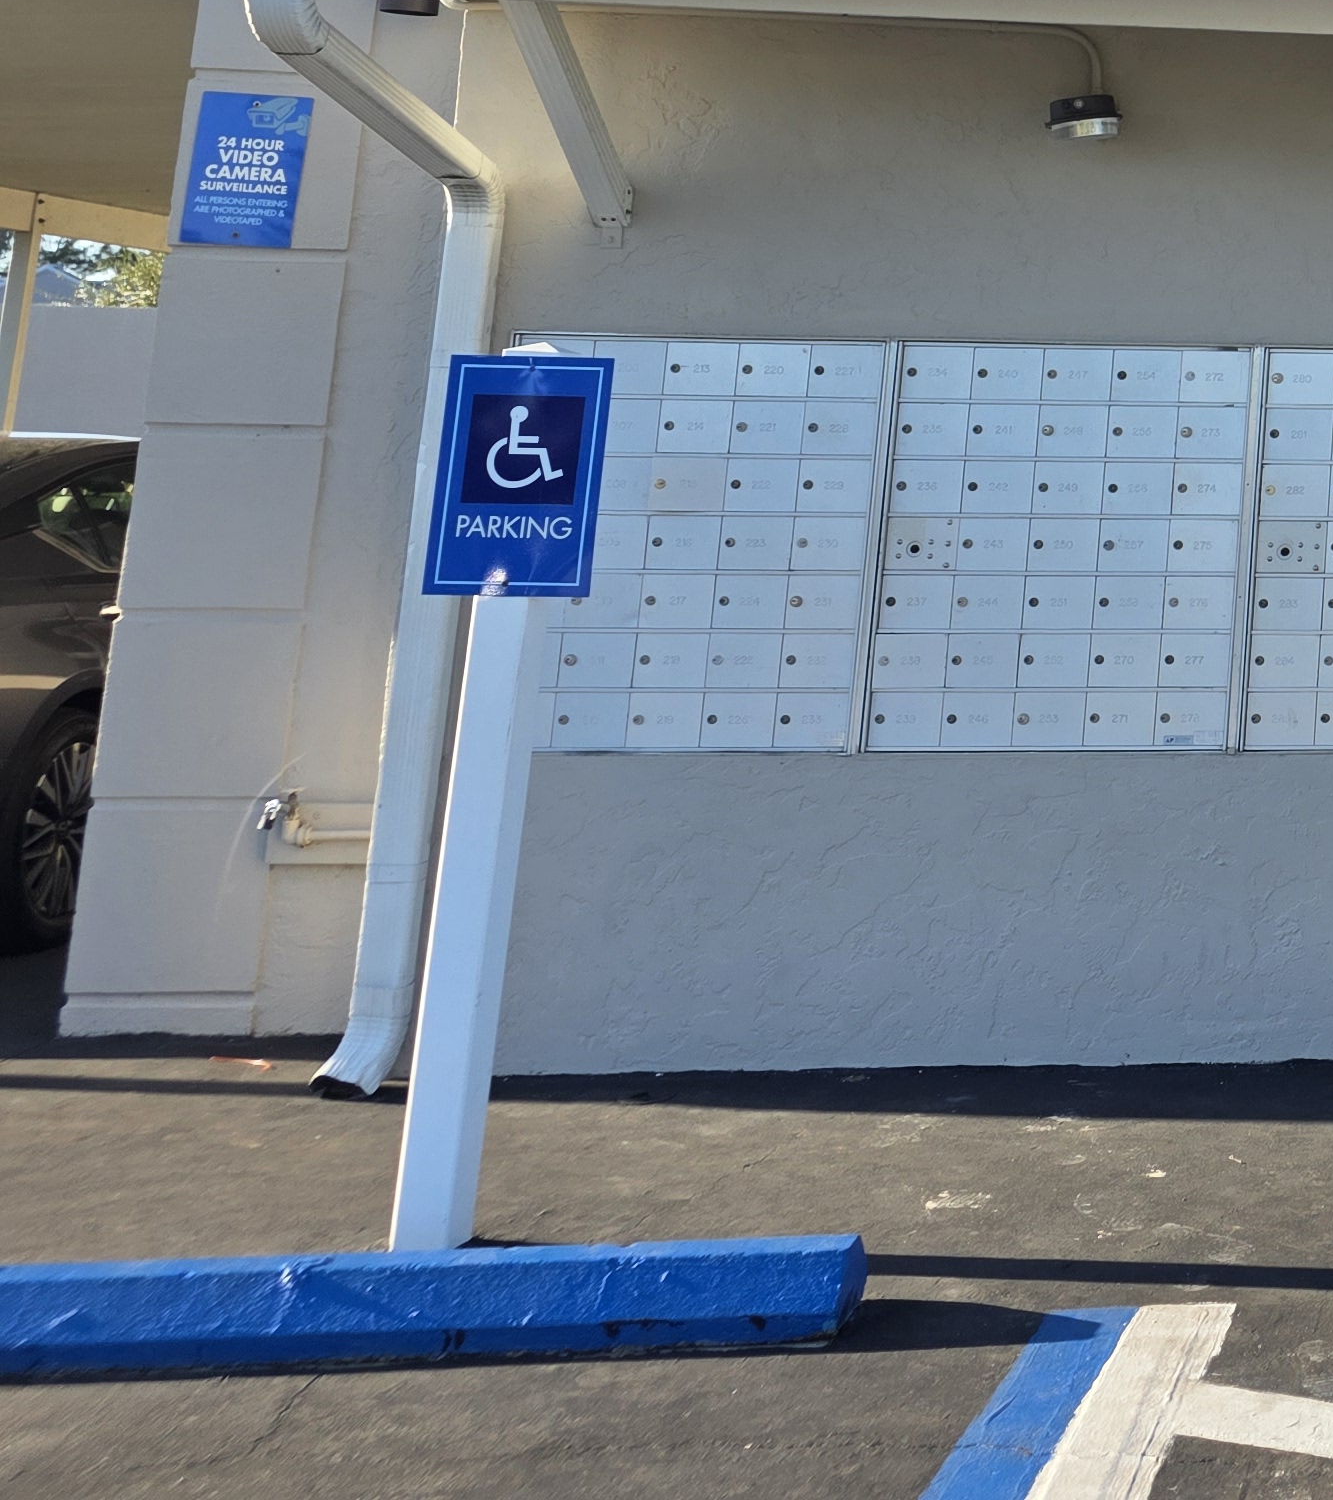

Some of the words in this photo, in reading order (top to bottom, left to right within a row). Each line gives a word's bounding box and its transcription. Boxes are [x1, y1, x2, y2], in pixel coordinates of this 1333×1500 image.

[217, 136, 236, 148] 24
[241, 138, 284, 151] HOUR
[219, 149, 279, 166] VIDEO
[205, 164, 286, 183] CAMERA
[199, 181, 288, 195] SURVEILLANCE
[194, 196, 208, 204] ALL
[209, 196, 246, 206] PERSONS
[247, 198, 288, 208] ENTERING
[193, 205, 210, 214] ARE
[211, 206, 277, 217] PHOTOGRAPHED
[278, 210, 285, 218] &
[214, 215, 263, 226] VIDEOTAPED
[692, 363, 711, 374] 213
[763, 364, 785, 375] 220
[834, 366, 856, 377] 227
[997, 368, 1019, 379] 240
[1136, 370, 1156, 381] 254
[1205, 372, 1224, 382] 272
[1292, 374, 1313, 384] 280
[686, 421, 704, 431] 214
[759, 422, 777, 433] 221
[828, 423, 849, 434] 228
[921, 424, 943, 434] 235
[994, 424, 1013, 435] 241
[1063, 425, 1084, 436] 248
[1201, 427, 1221, 438] 273
[1290, 429, 1308, 440] 281
[823, 480, 845, 491] 229
[916, 481, 938, 491] 236
[988, 481, 1009, 492] 242
[1057, 482, 1079, 493] 249
[1197, 483, 1217, 494] 274
[1285, 485, 1306, 496] 282
[455, 515, 573, 540] PARKING
[745, 537, 767, 548] 223
[983, 539, 1004, 550] 243
[1053, 539, 1074, 550] 250
[1192, 540, 1213, 551] 275
[668, 595, 687, 606] 217
[813, 596, 832, 607] 231
[906, 596, 928, 607] 237
[977, 597, 999, 608] 244
[1188, 597, 1209, 608] 276
[1113, 655, 1135, 666] 270
[1184, 655, 1205, 665] 277
[727, 714, 749, 725] 226
[801, 714, 823, 725] 233
[895, 713, 917, 725] 239
[967, 713, 989, 725] 246
[1111, 713, 1129, 724] 271
